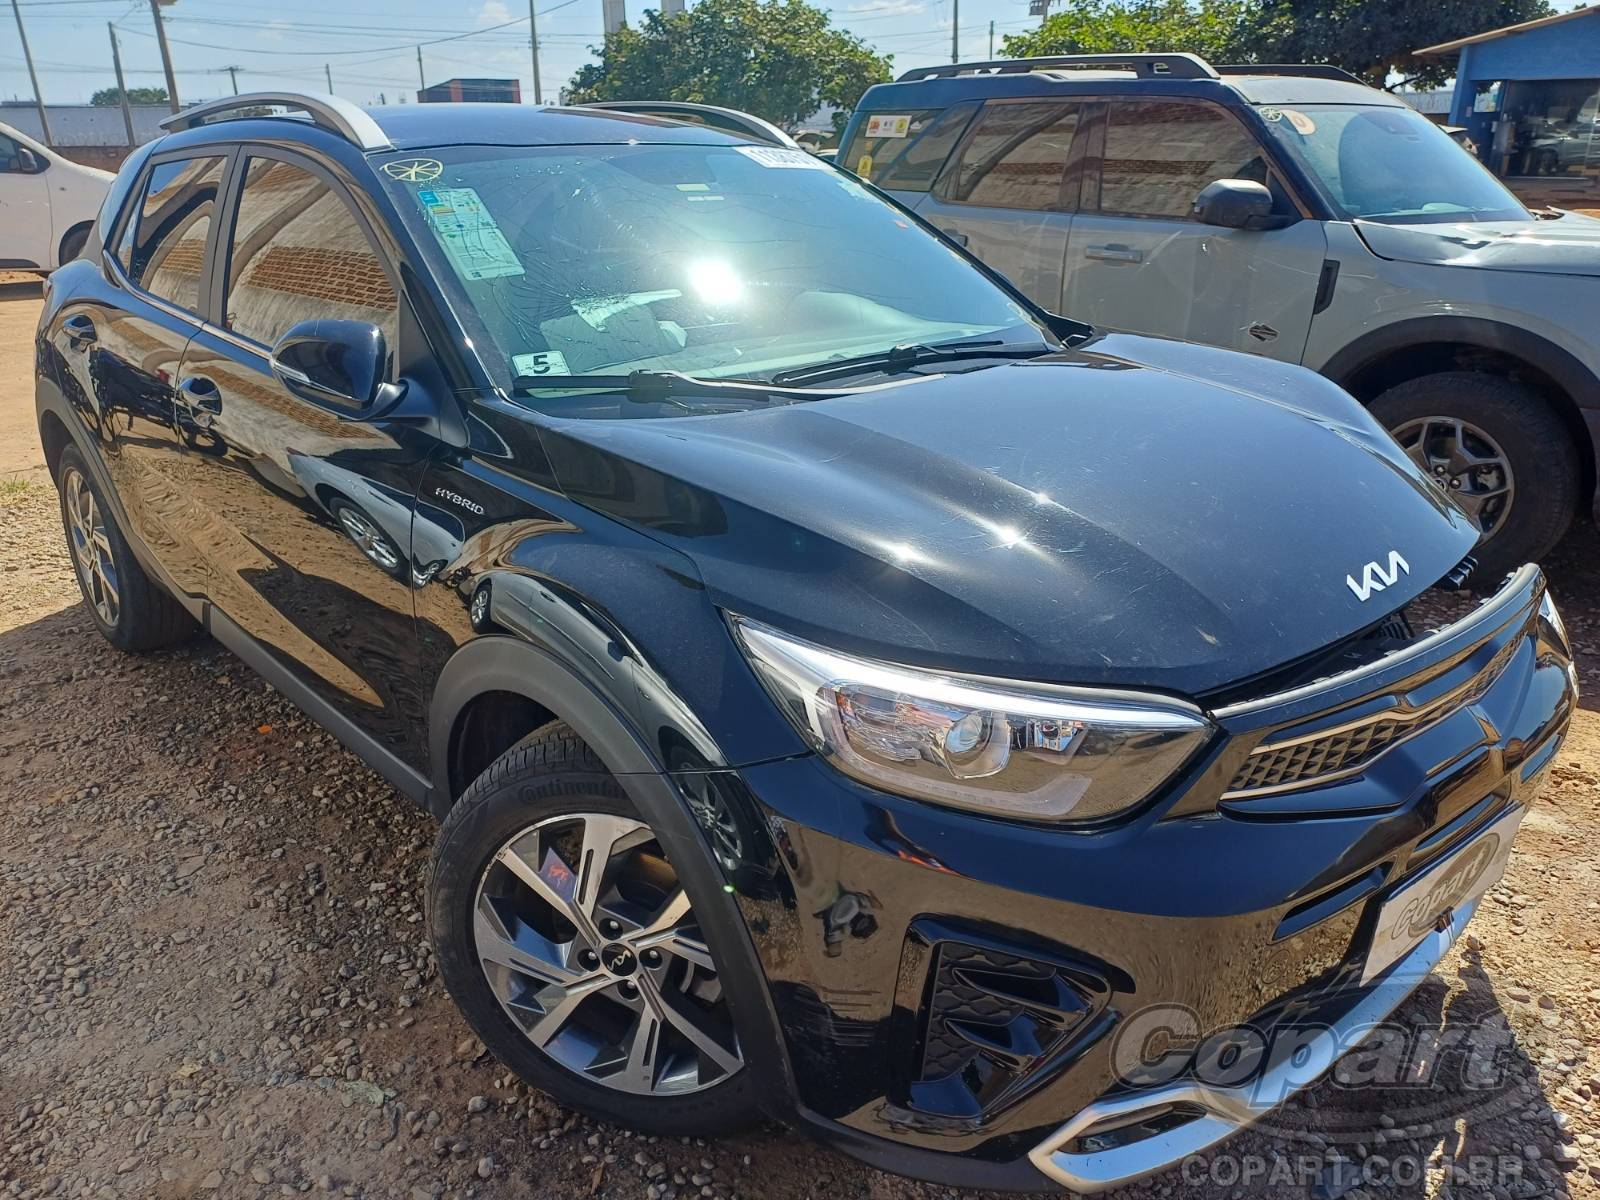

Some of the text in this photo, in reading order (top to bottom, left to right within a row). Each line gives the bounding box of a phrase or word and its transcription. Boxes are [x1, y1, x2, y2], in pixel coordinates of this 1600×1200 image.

[533, 354, 551, 375] 5
[434, 487, 486, 515] HYBRID
[1390, 840, 1491, 942] Copart
